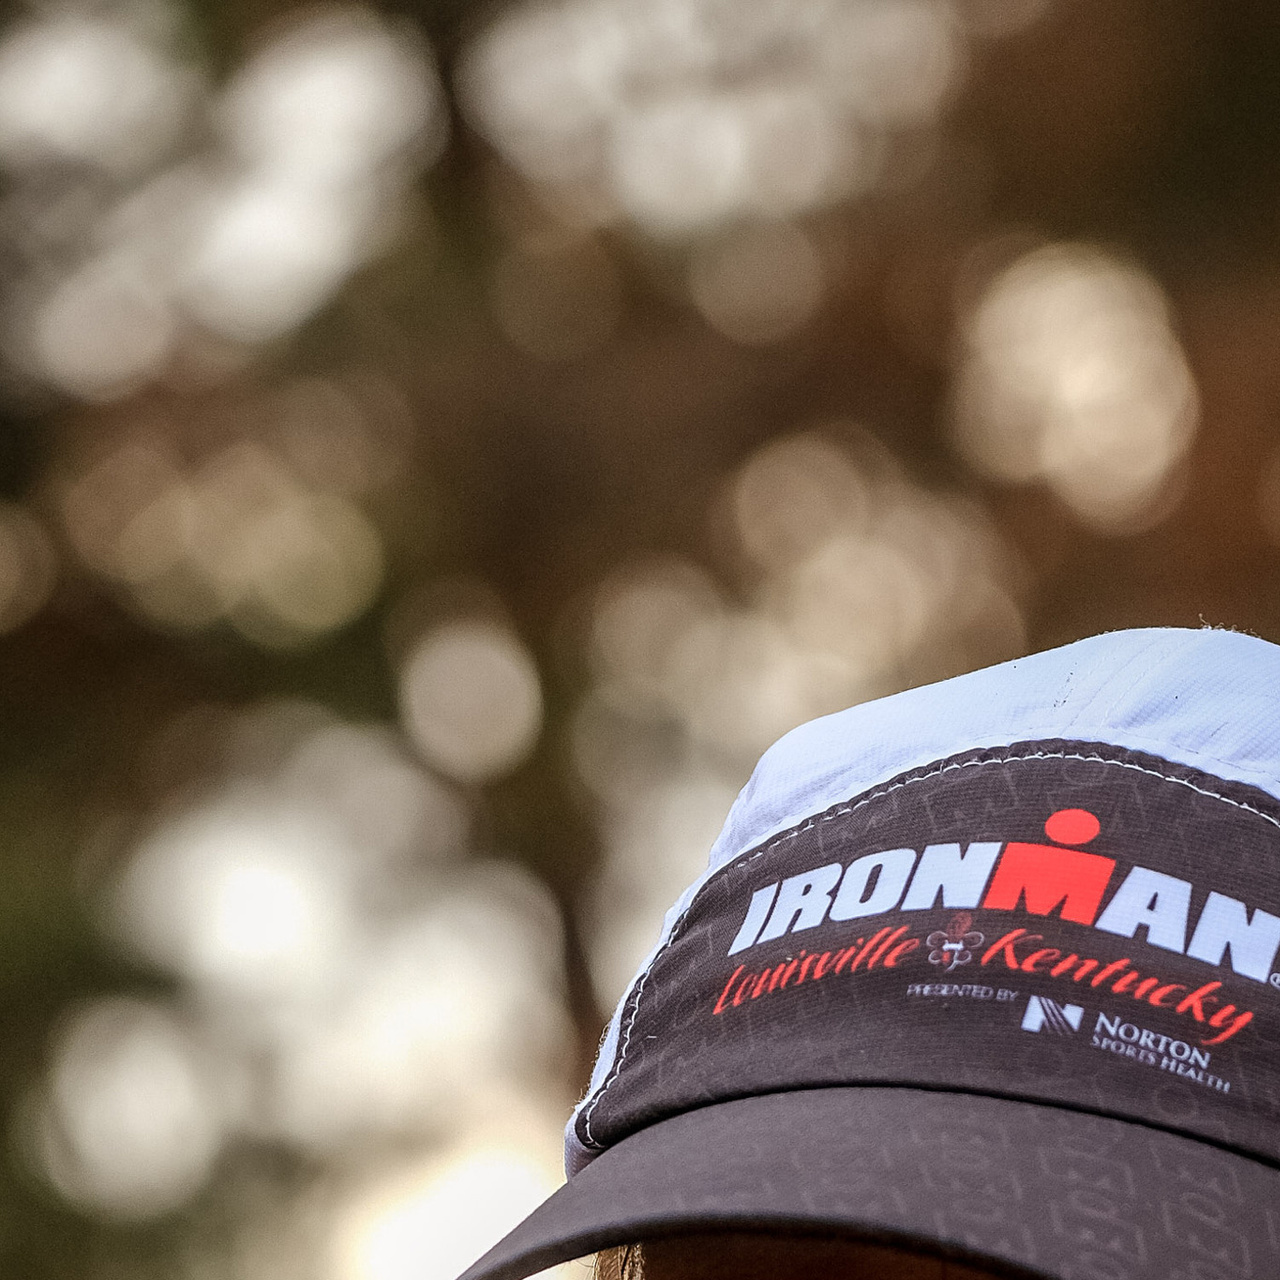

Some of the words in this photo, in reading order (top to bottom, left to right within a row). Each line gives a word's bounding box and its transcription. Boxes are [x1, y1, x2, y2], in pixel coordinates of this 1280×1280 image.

[712, 924, 922, 1015] Louisville
[981, 928, 1254, 1046] Kentucky
[906, 983, 994, 1000] PRESENTED
[995, 988, 1019, 1001] BY
[1089, 1034, 1157, 1066] SPORTS
[1159, 1053, 1232, 1094] HEALTH
[1094, 1011, 1211, 1071] NORTON
